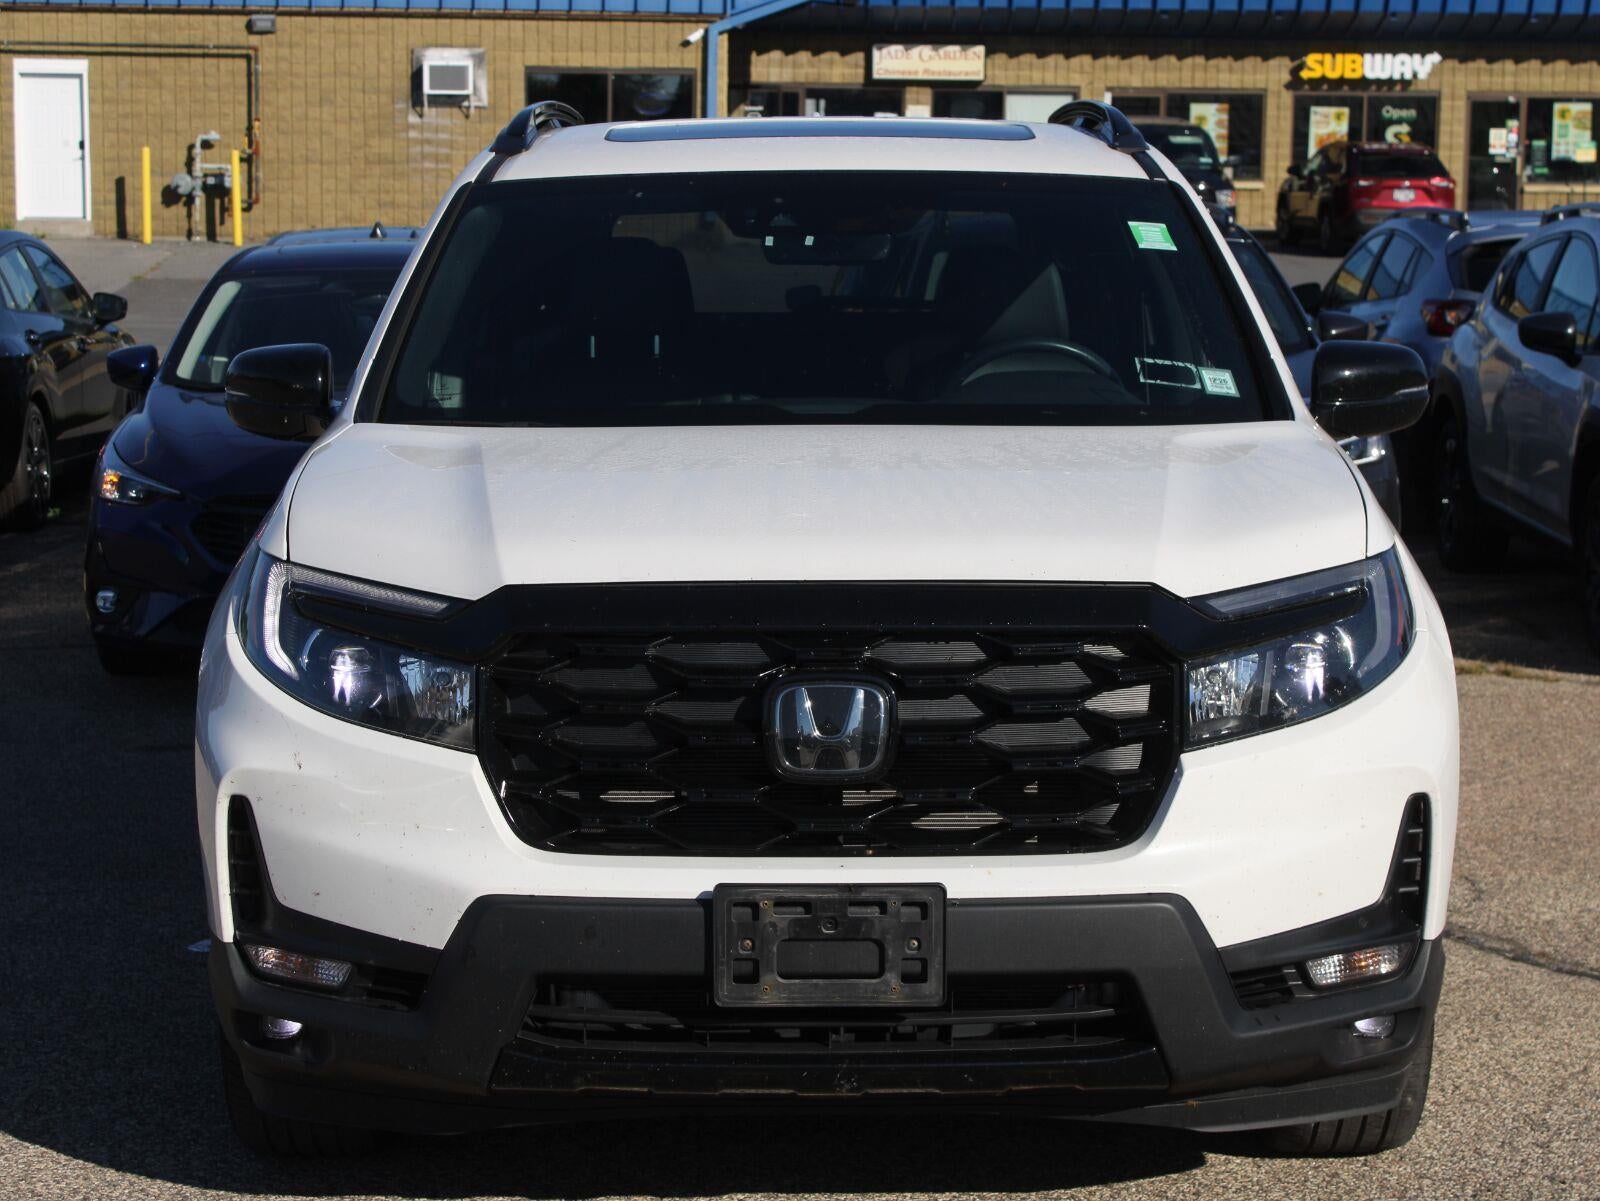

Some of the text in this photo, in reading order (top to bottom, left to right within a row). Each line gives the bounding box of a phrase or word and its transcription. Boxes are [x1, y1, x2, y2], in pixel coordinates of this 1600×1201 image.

[919, 47, 981, 62] GARDEN
[876, 68, 981, 77] Chinese Restaurant
[1299, 51, 1442, 80] SUBWAY
[1381, 105, 1417, 120] Open
